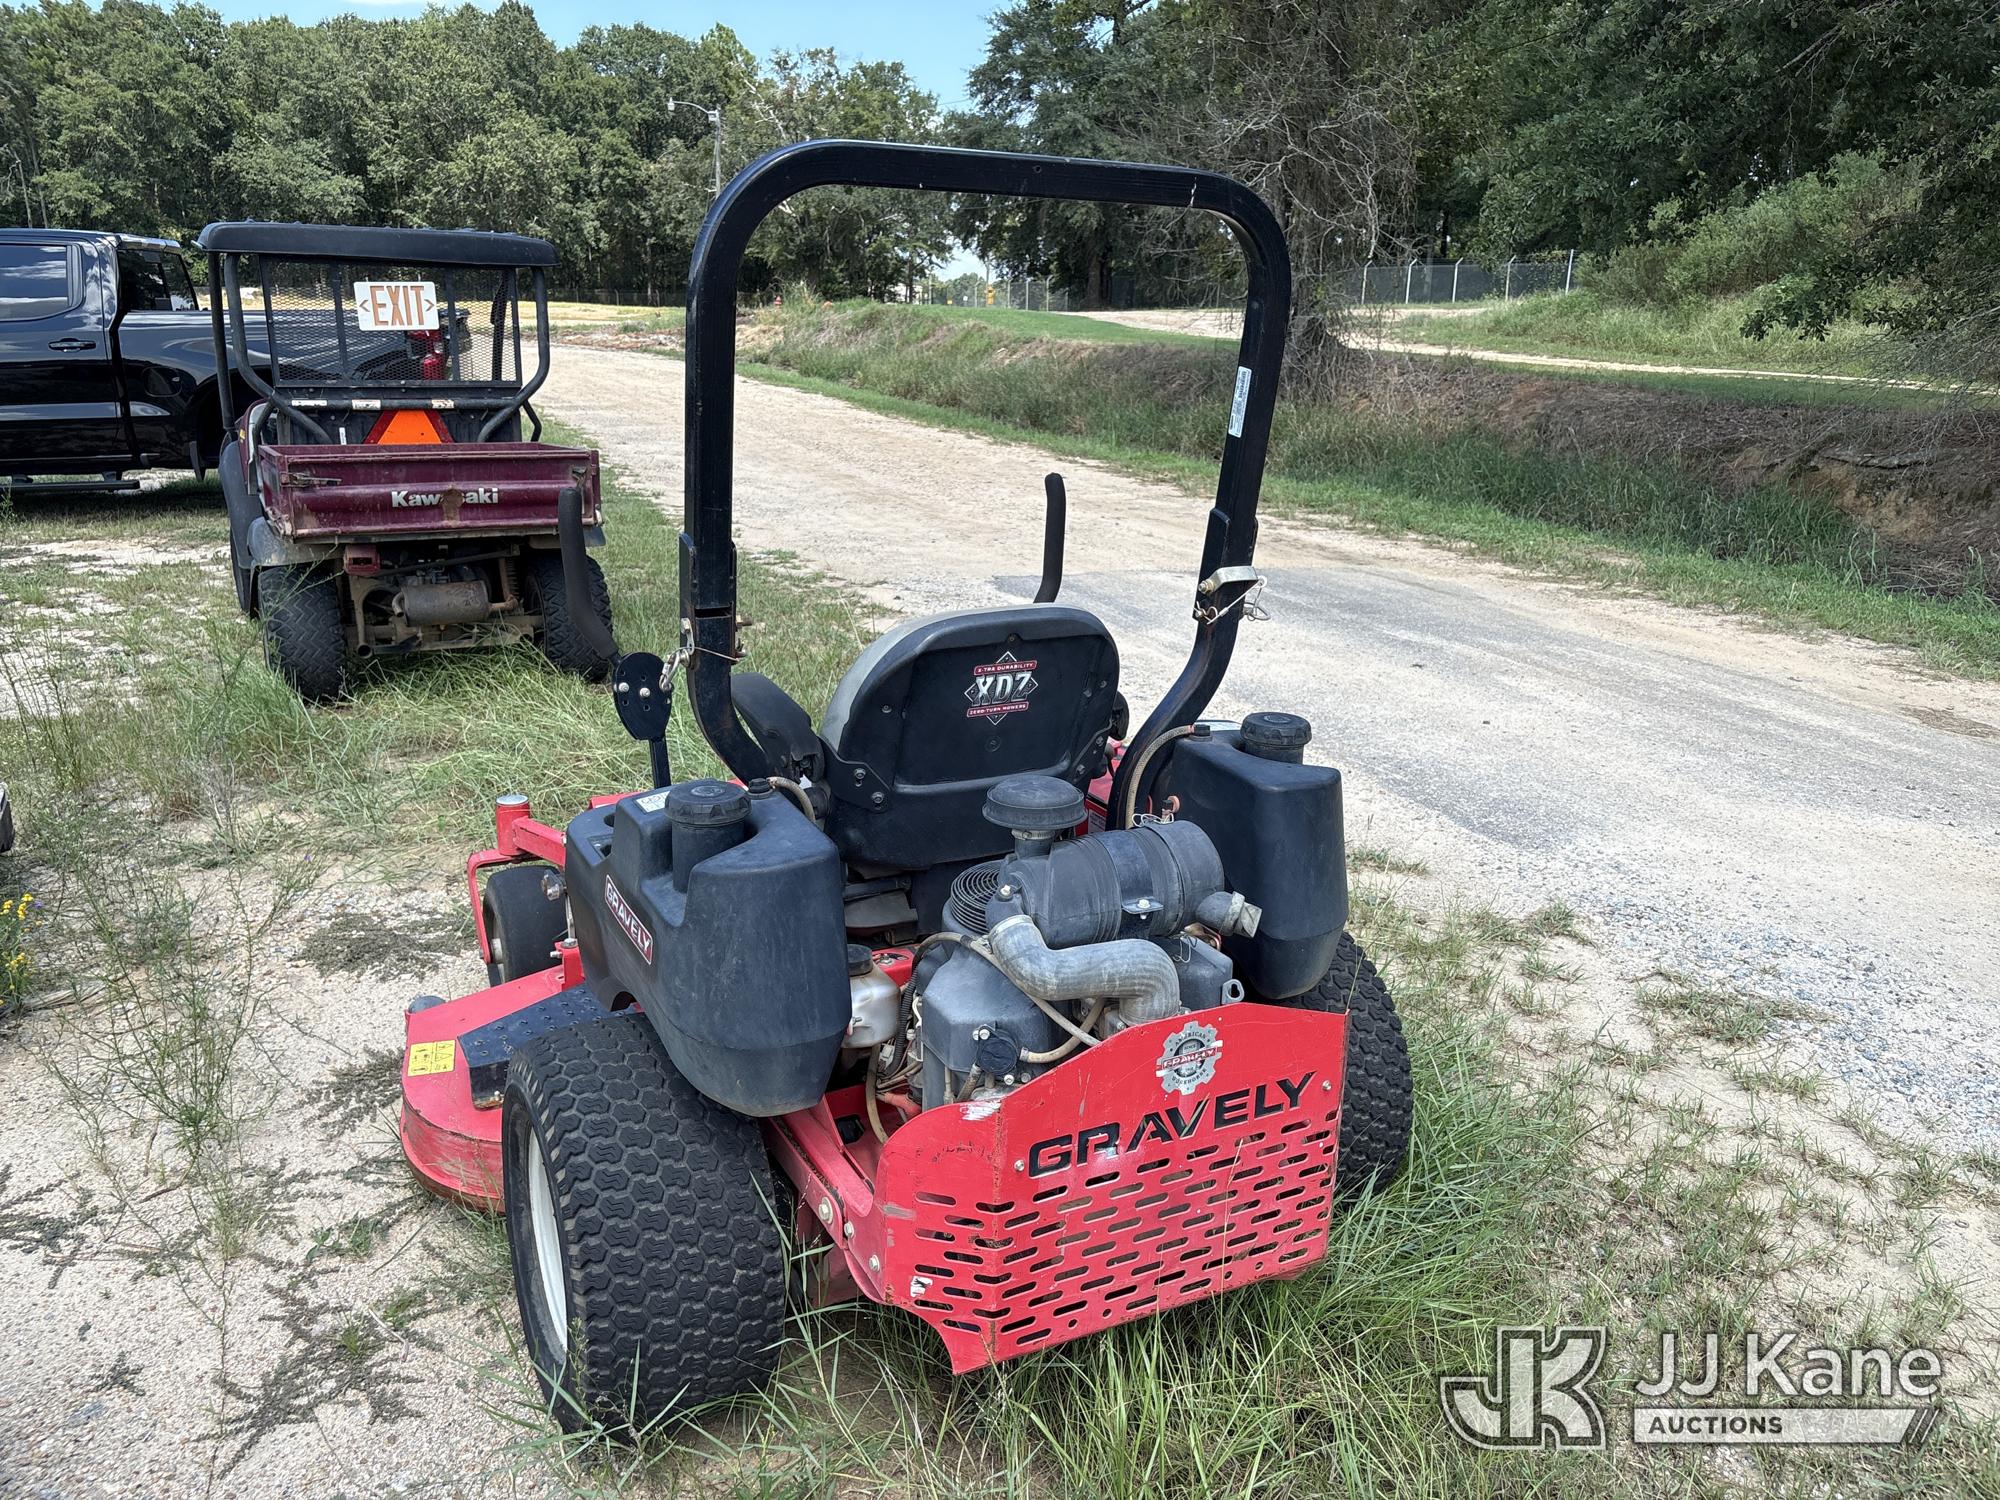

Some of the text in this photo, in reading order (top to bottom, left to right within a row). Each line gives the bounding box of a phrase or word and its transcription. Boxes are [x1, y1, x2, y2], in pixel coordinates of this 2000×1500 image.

[369, 285, 425, 326] EXIT
[391, 487, 499, 508] Kawaki
[997, 662, 1034, 671] DURABILITY
[971, 671, 1032, 707] XDZ
[1002, 704, 1026, 712] MOWERS
[606, 882, 651, 952] GRAVELY
[1028, 1071, 1317, 1177] GRAVELY
